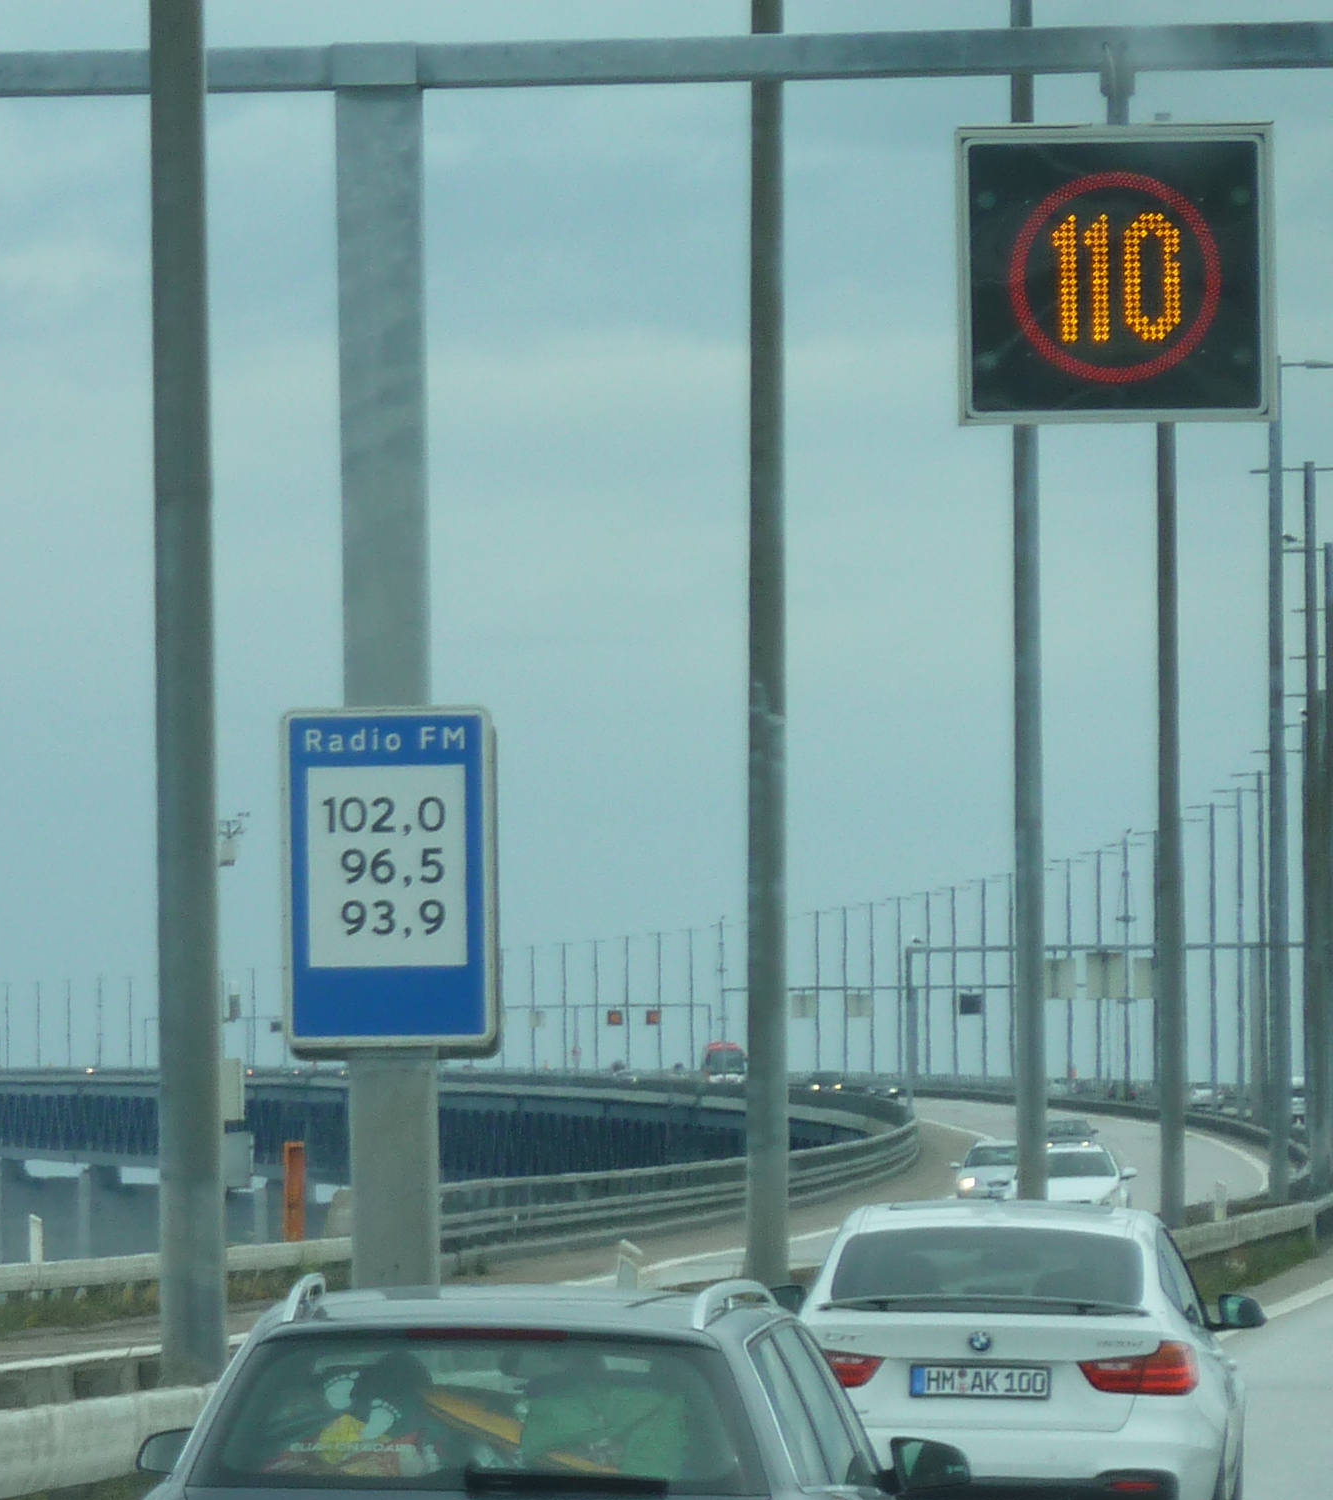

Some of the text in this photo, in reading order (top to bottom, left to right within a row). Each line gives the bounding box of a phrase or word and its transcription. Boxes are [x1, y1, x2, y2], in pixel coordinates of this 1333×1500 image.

[1050, 212, 1182, 344] 110
[305, 726, 467, 754] Radio FM
[321, 796, 446, 836] 102,0
[340, 847, 446, 887] 96,5
[340, 899, 446, 939] 93,9
[926, 1370, 1046, 1393] HM AK 100
